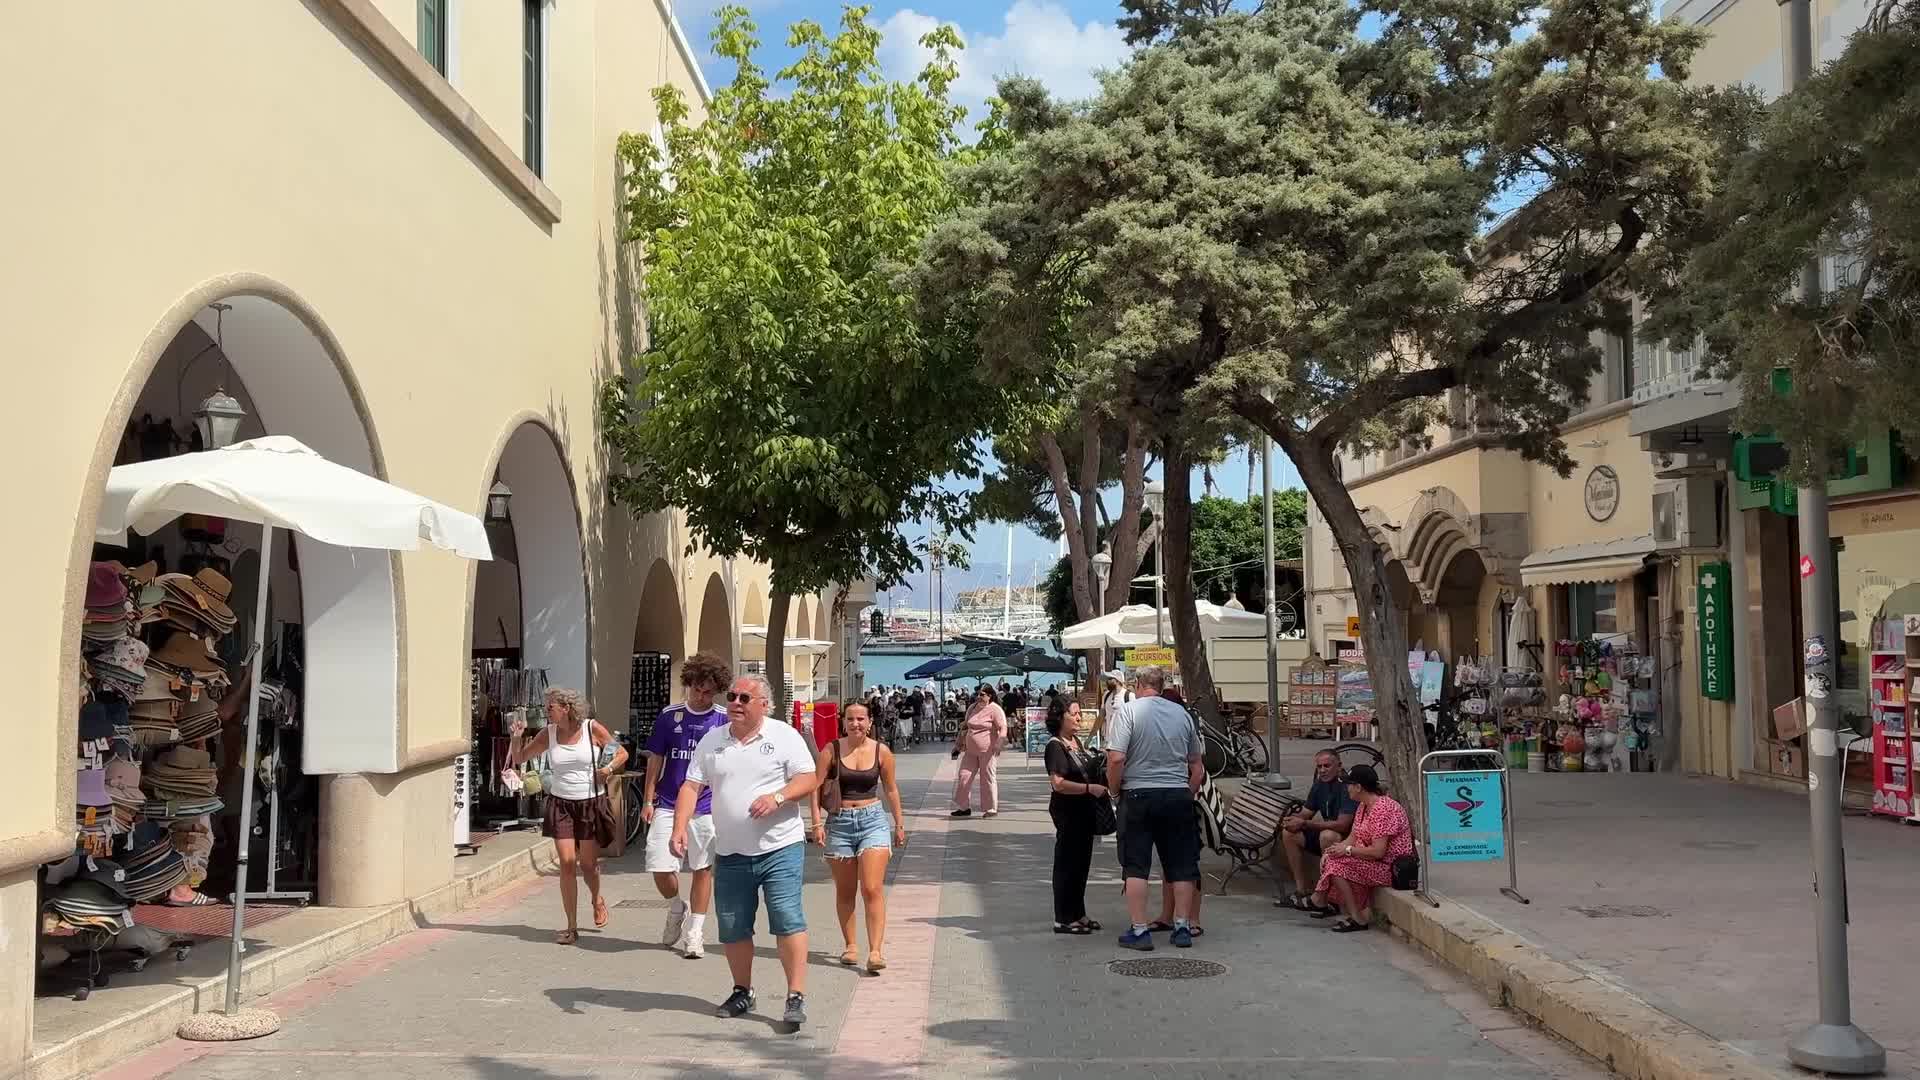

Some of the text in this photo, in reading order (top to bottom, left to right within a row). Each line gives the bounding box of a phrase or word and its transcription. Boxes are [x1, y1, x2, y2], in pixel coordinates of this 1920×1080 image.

[1704, 592, 1718, 692] APOTHEKE
[1130, 652, 1172, 662] EXCURSIONS
[1339, 649, 1364, 657] BODR
